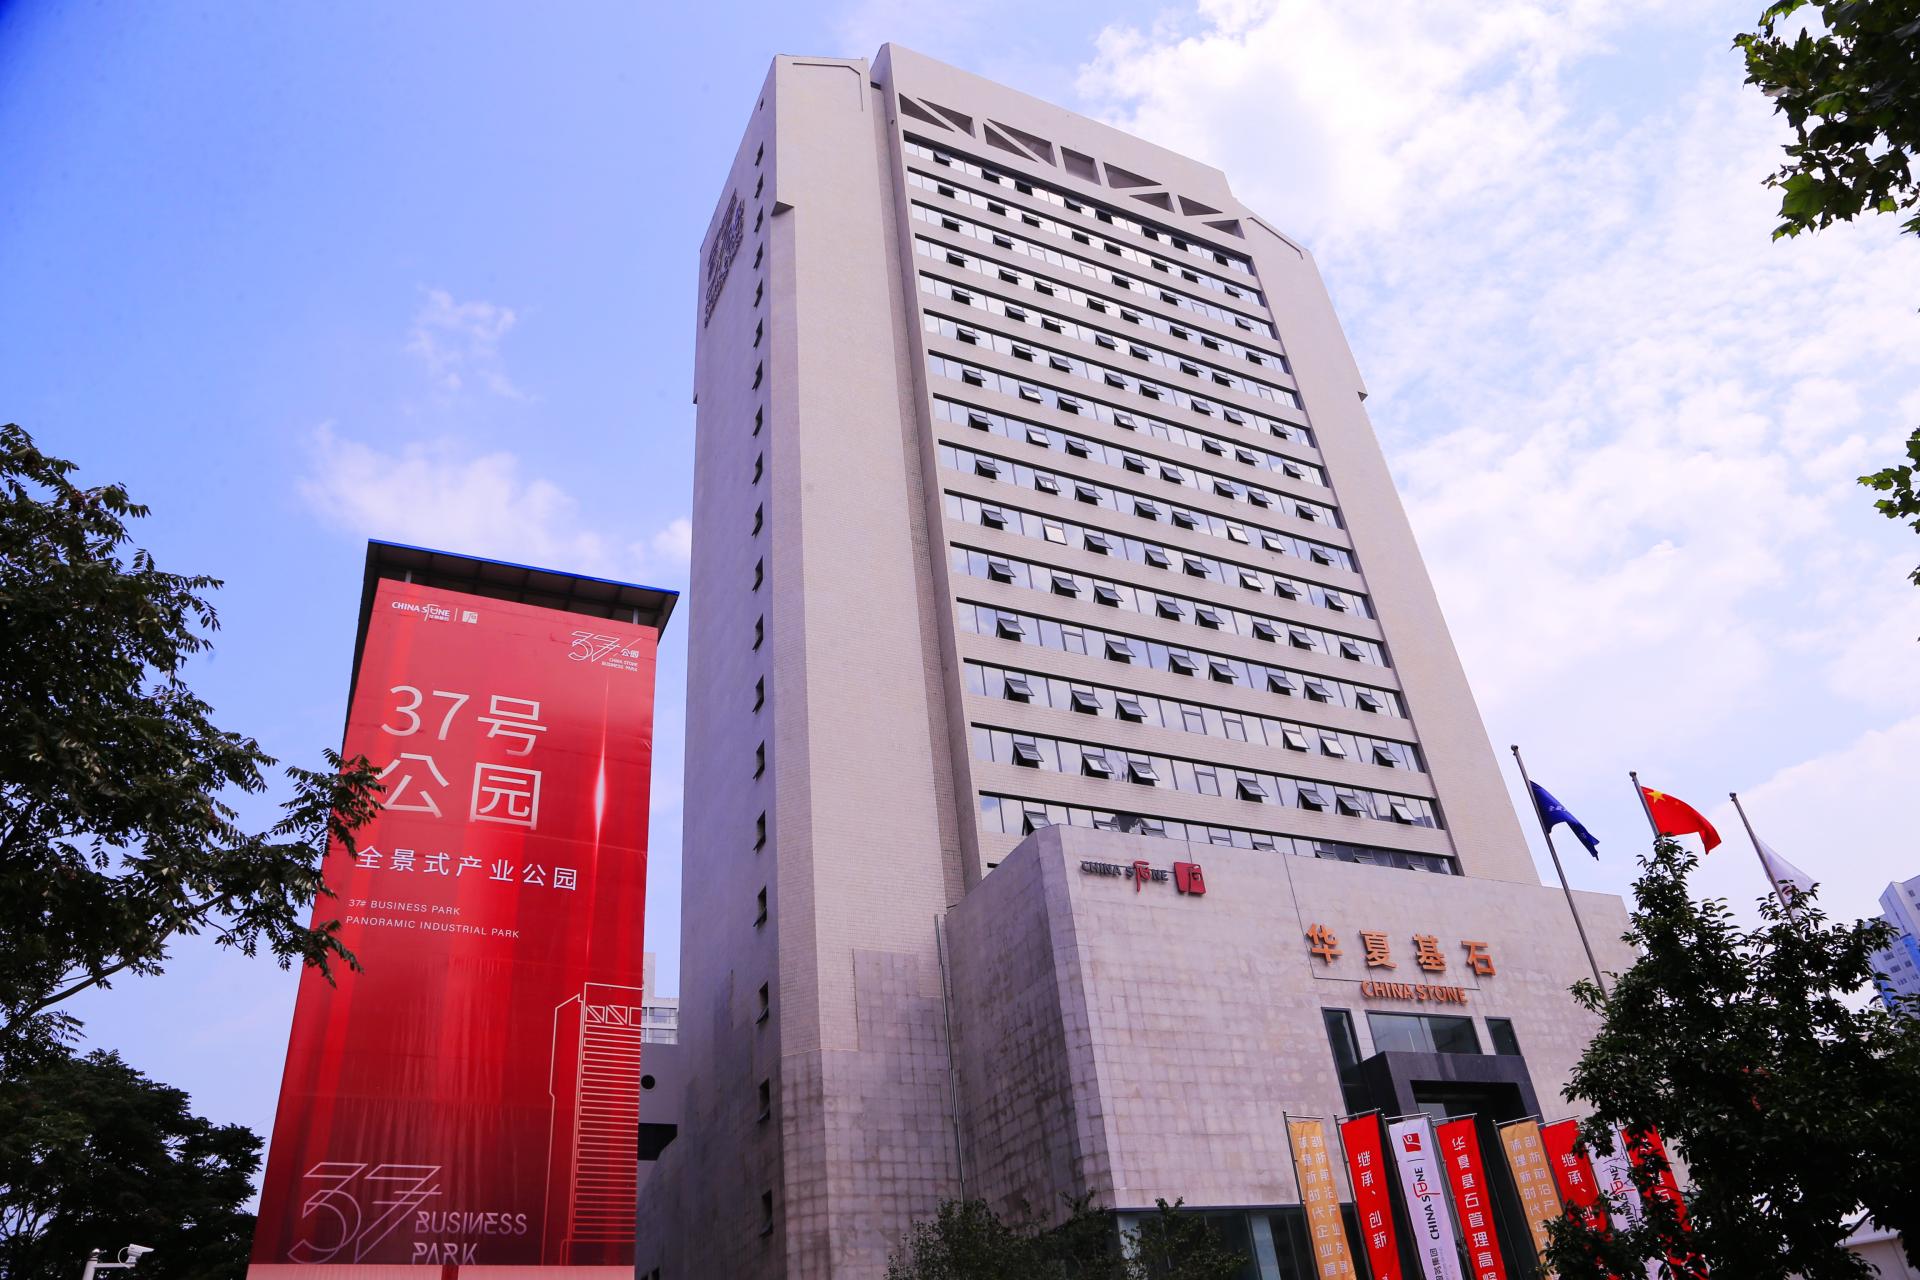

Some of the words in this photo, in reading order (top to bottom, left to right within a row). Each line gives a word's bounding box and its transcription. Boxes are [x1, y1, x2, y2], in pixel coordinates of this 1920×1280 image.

[391, 601, 420, 612] CHINA
[381, 685, 547, 757] 37号
[376, 752, 542, 830] 公园
[355, 845, 577, 890] 全景式产业公园
[1080, 861, 1122, 876] CHINA
[370, 900, 428, 913] BUSINESS
[431, 905, 461, 916] PARK
[346, 915, 416, 929] PANORAMIC
[419, 922, 488, 936] INDUSTRIAL
[491, 928, 520, 939] PARK
[1306, 922, 1497, 977] 华夏基石
[1361, 980, 1414, 1001] CHINA
[1414, 983, 1468, 1006] STONE
[287, 1161, 443, 1265] 37
[414, 1210, 528, 1236] BUSINESS
[1423, 1204, 1440, 1240] CHINA
[412, 1241, 479, 1265] PARK
